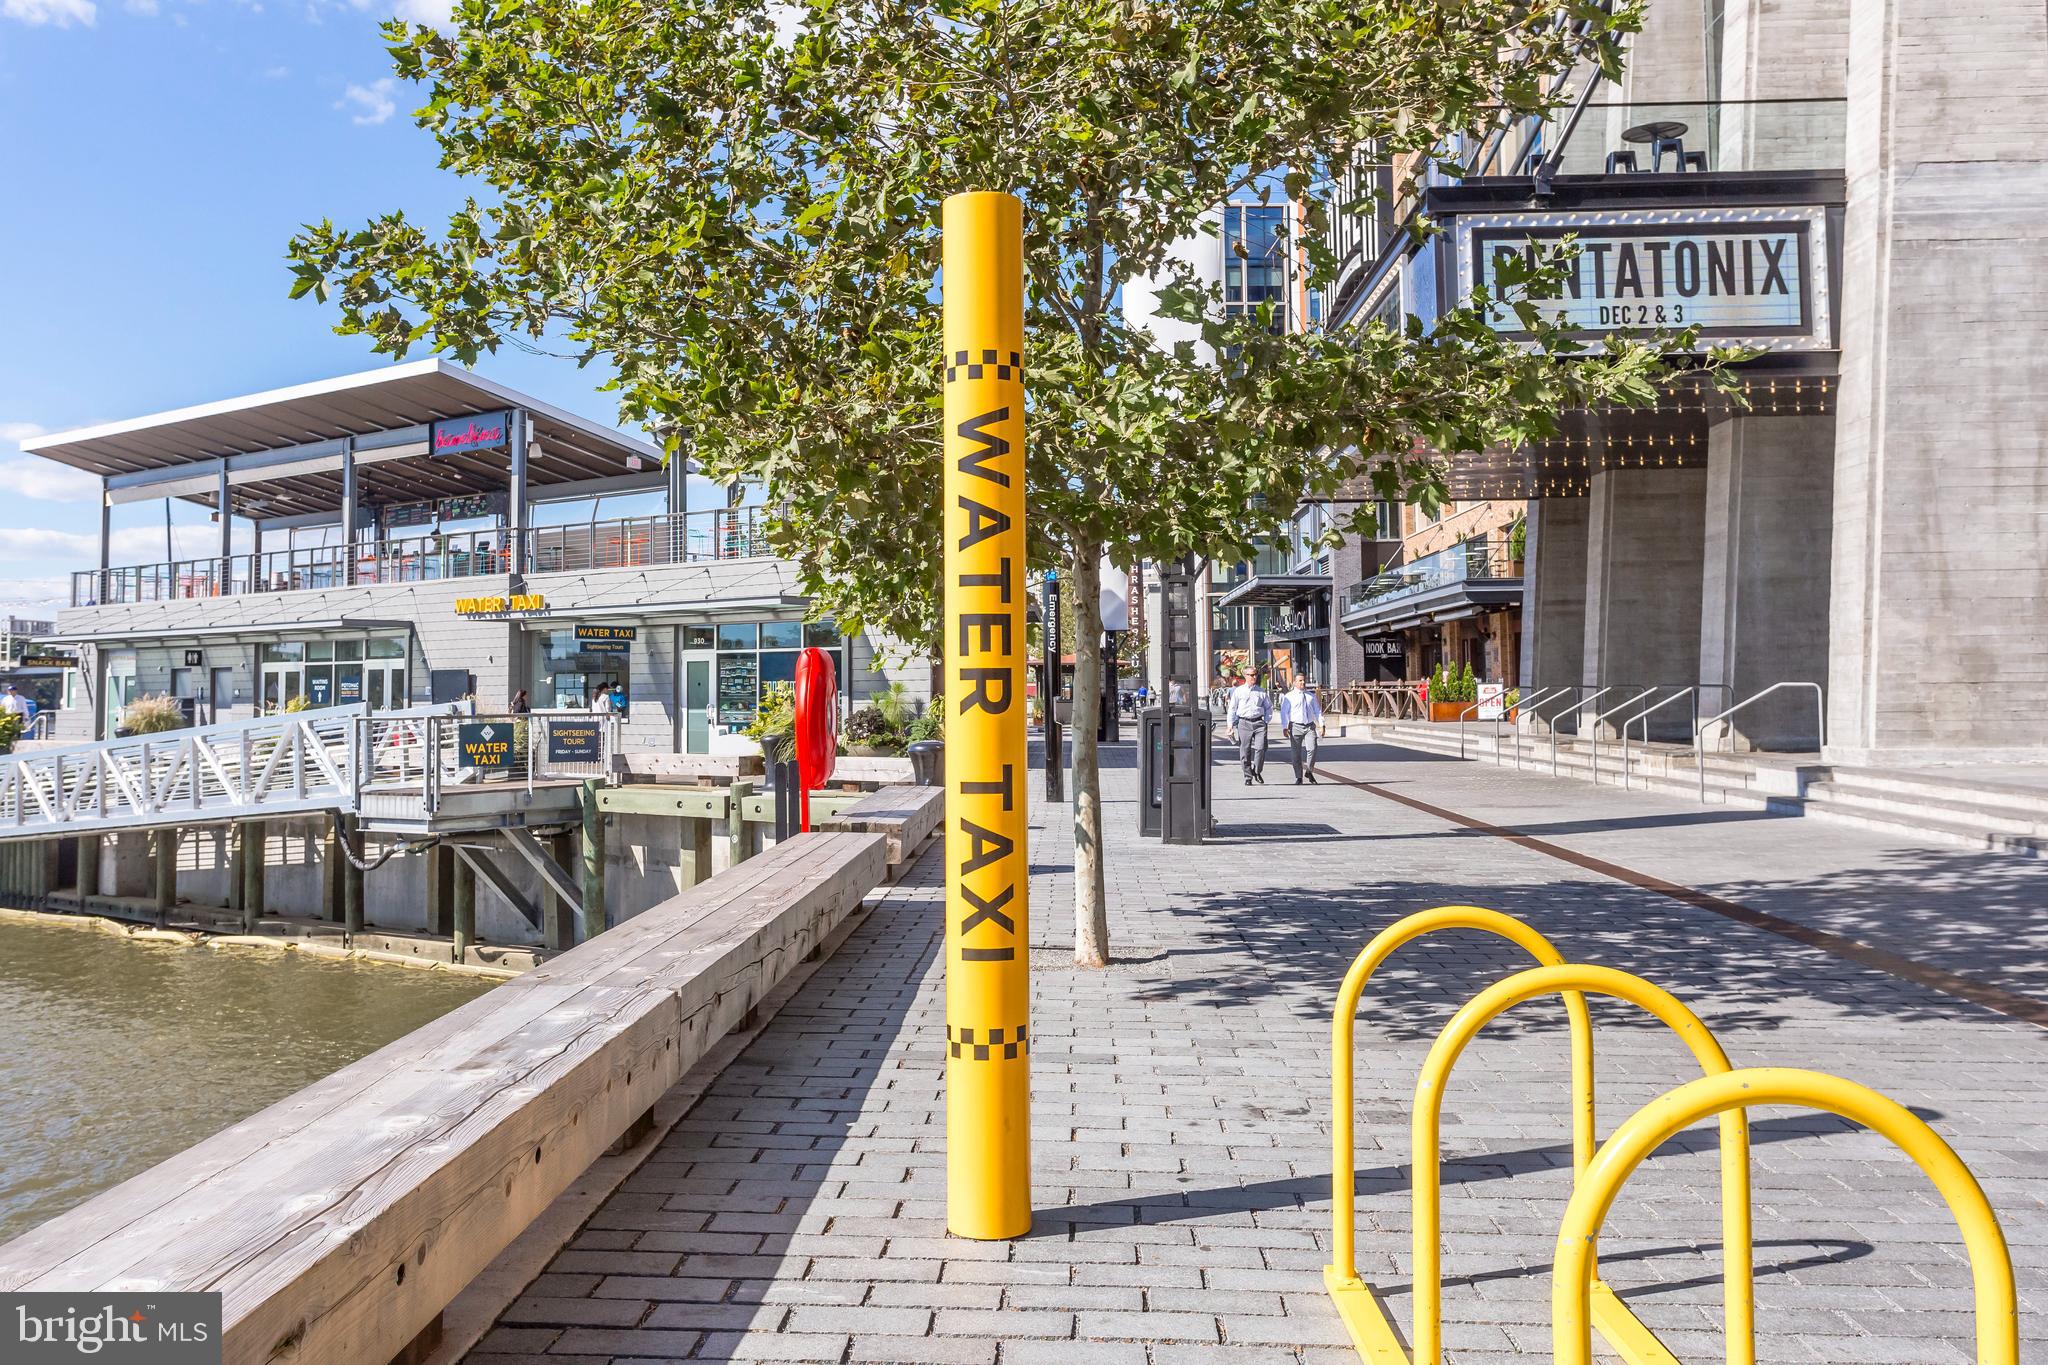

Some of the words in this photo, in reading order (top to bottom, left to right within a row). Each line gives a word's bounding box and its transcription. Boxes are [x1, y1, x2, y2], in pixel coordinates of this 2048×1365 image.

[1600, 305, 1631, 325] DEC
[1638, 305, 1648, 324] 2
[1655, 304, 1667, 323] &
[1674, 304, 1683, 323] 3
[957, 406, 1013, 716] WATER
[456, 597, 504, 614] WATER
[510, 594, 543, 611] TAXI
[1048, 594, 1057, 653] Emergency
[578, 628, 610, 637] WATER
[613, 629, 634, 638] TAXI
[693, 637, 705, 645] 930
[1365, 643, 1383, 654] NOOK
[1387, 643, 1402, 654] BAR
[552, 729, 595, 737] SIGHTSEEING
[465, 742, 508, 754] WATER
[473, 754, 500, 765] TAXI
[960, 763, 1015, 962] TAXI
